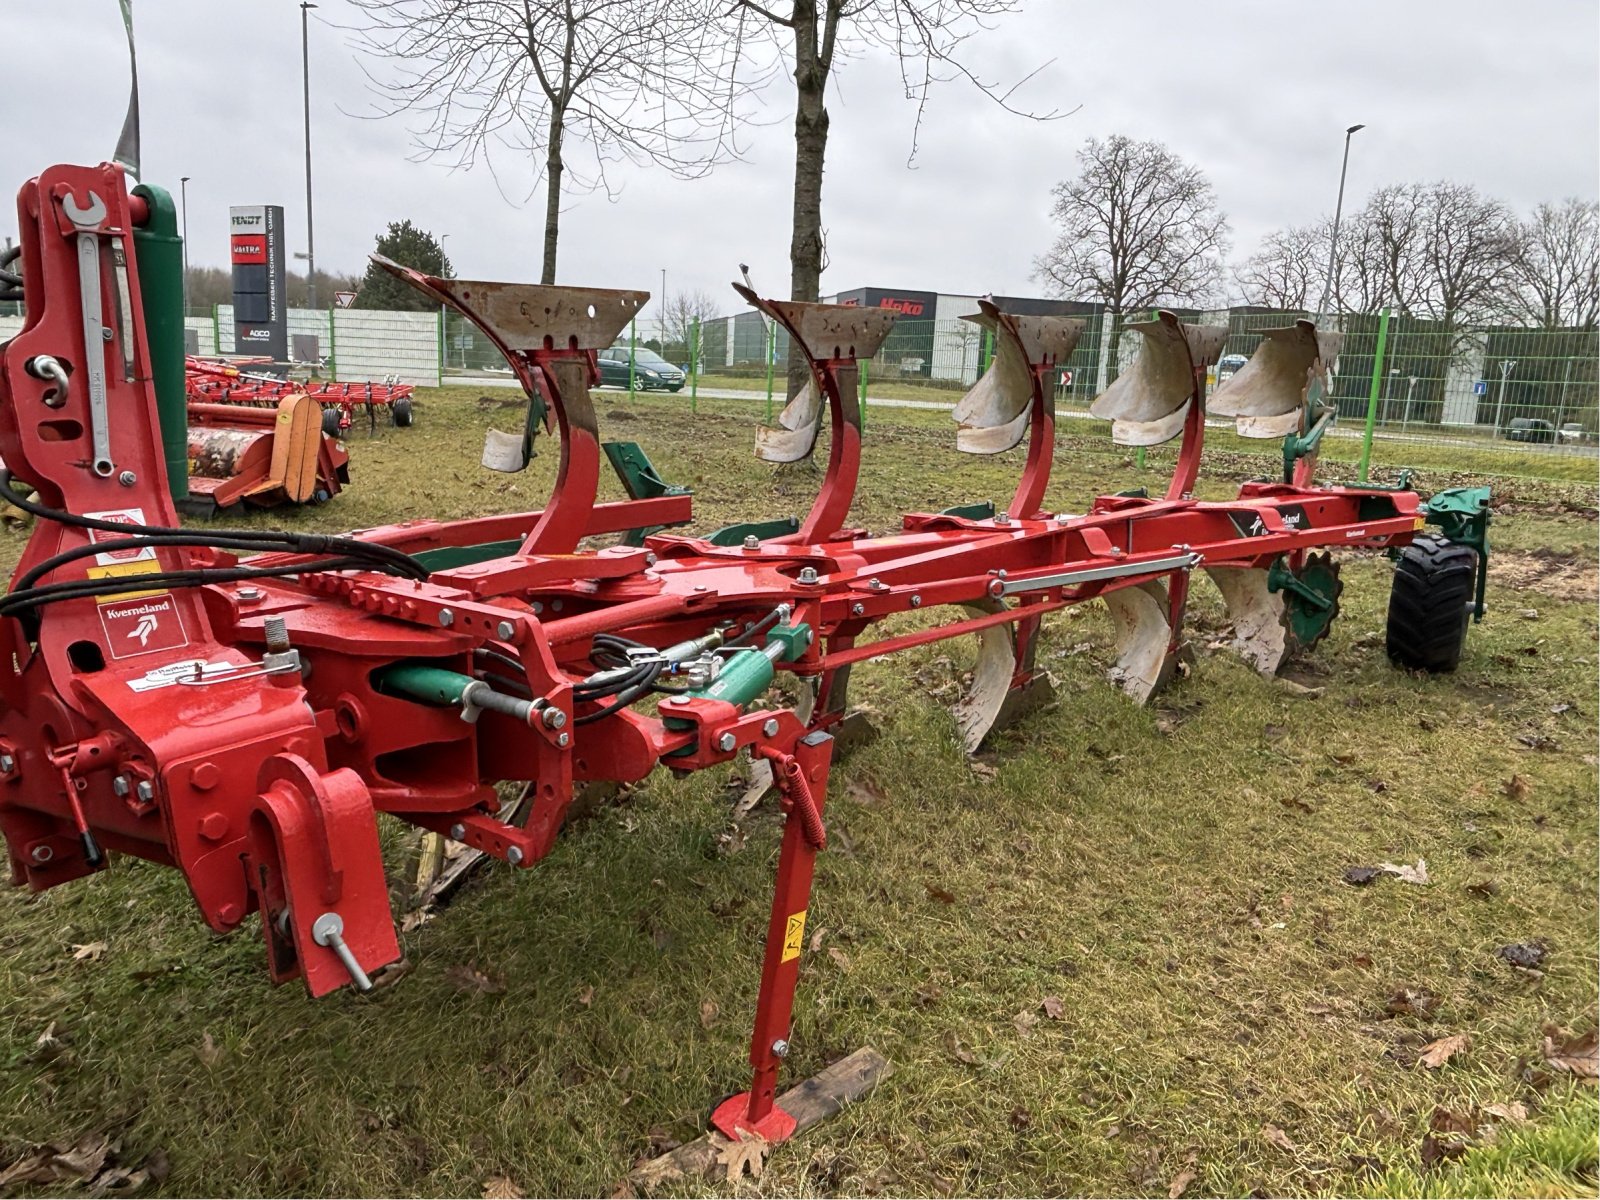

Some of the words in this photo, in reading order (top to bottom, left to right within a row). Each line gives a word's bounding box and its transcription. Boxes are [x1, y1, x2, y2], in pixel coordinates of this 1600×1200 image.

[232, 215, 262, 225] FENDT
[249, 329, 270, 337] AGCO
[106, 601, 170, 619] Kverneland
